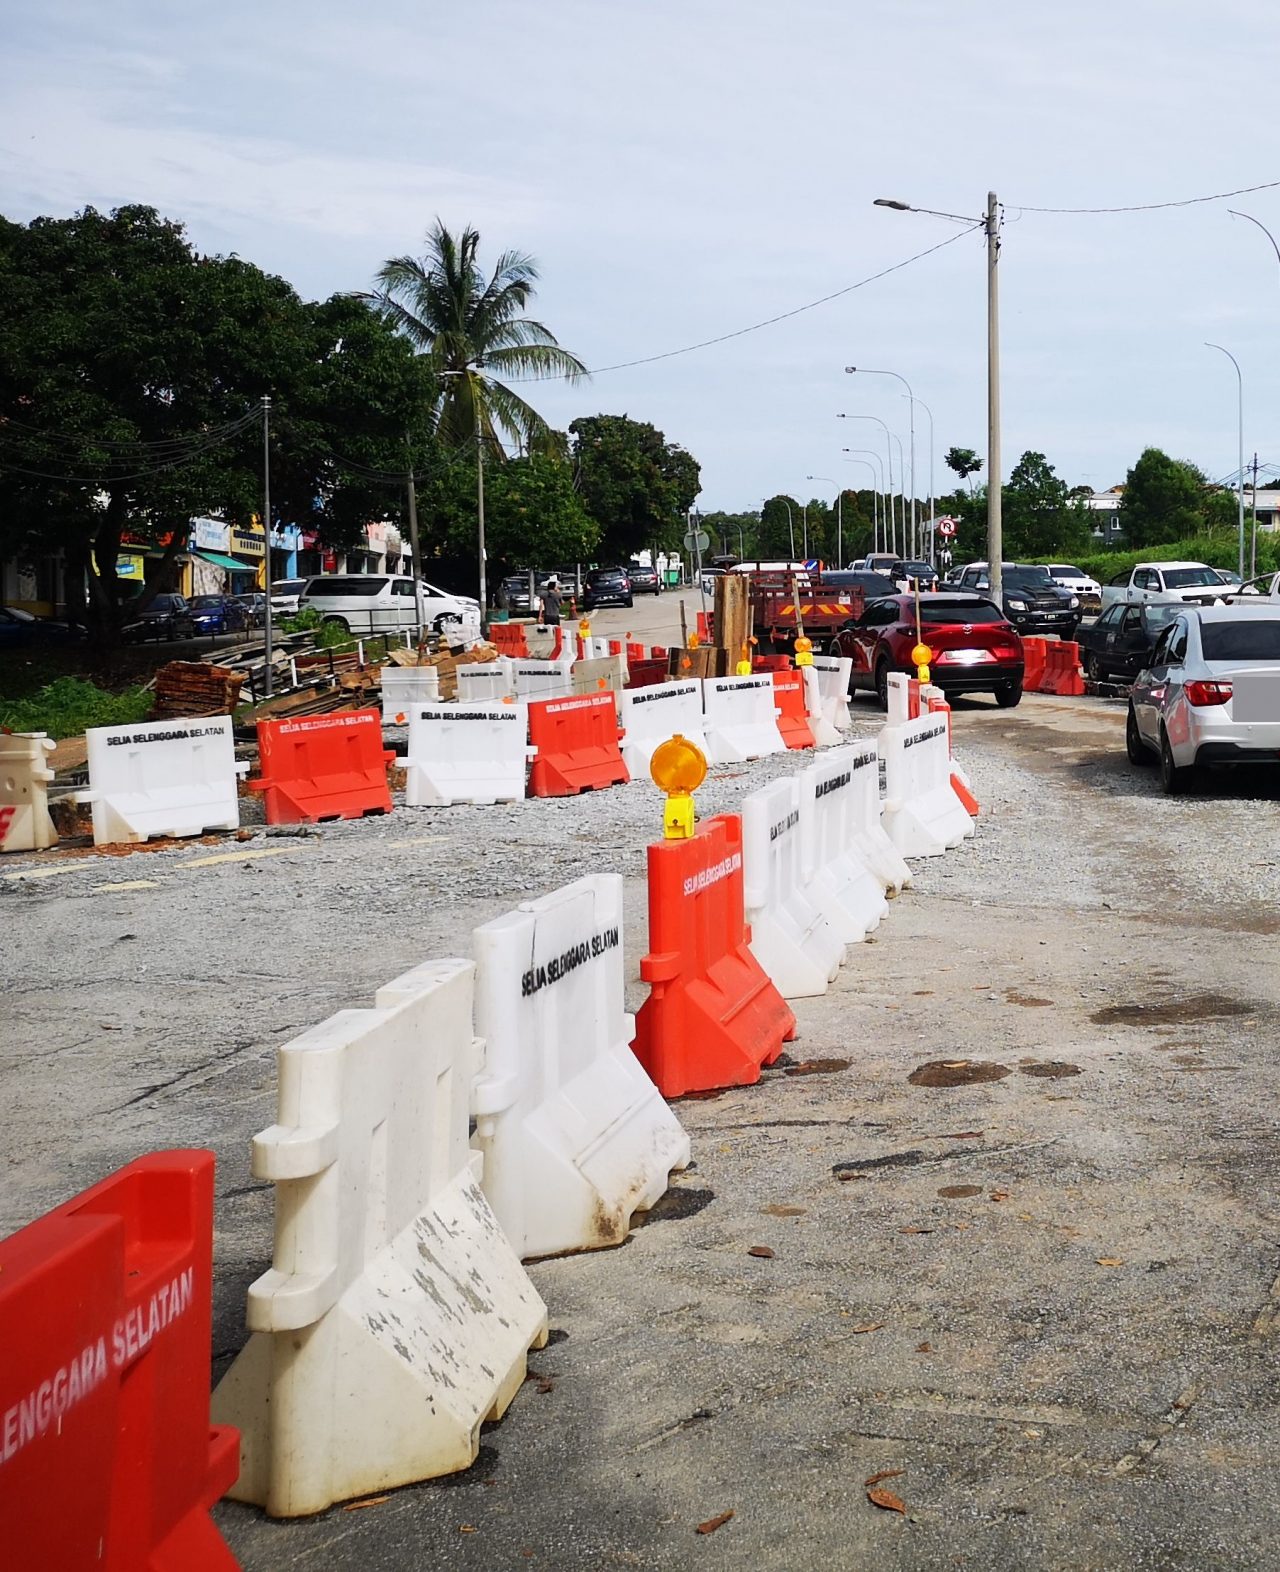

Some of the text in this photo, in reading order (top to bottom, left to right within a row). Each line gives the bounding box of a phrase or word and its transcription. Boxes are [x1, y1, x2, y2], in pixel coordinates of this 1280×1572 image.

[106, 735, 132, 746] SELIA
[189, 727, 225, 738] SELATAN
[521, 926, 618, 997] SELIA SELENGGARA SELATAN
[112, 1266, 194, 1367] SELATAN
